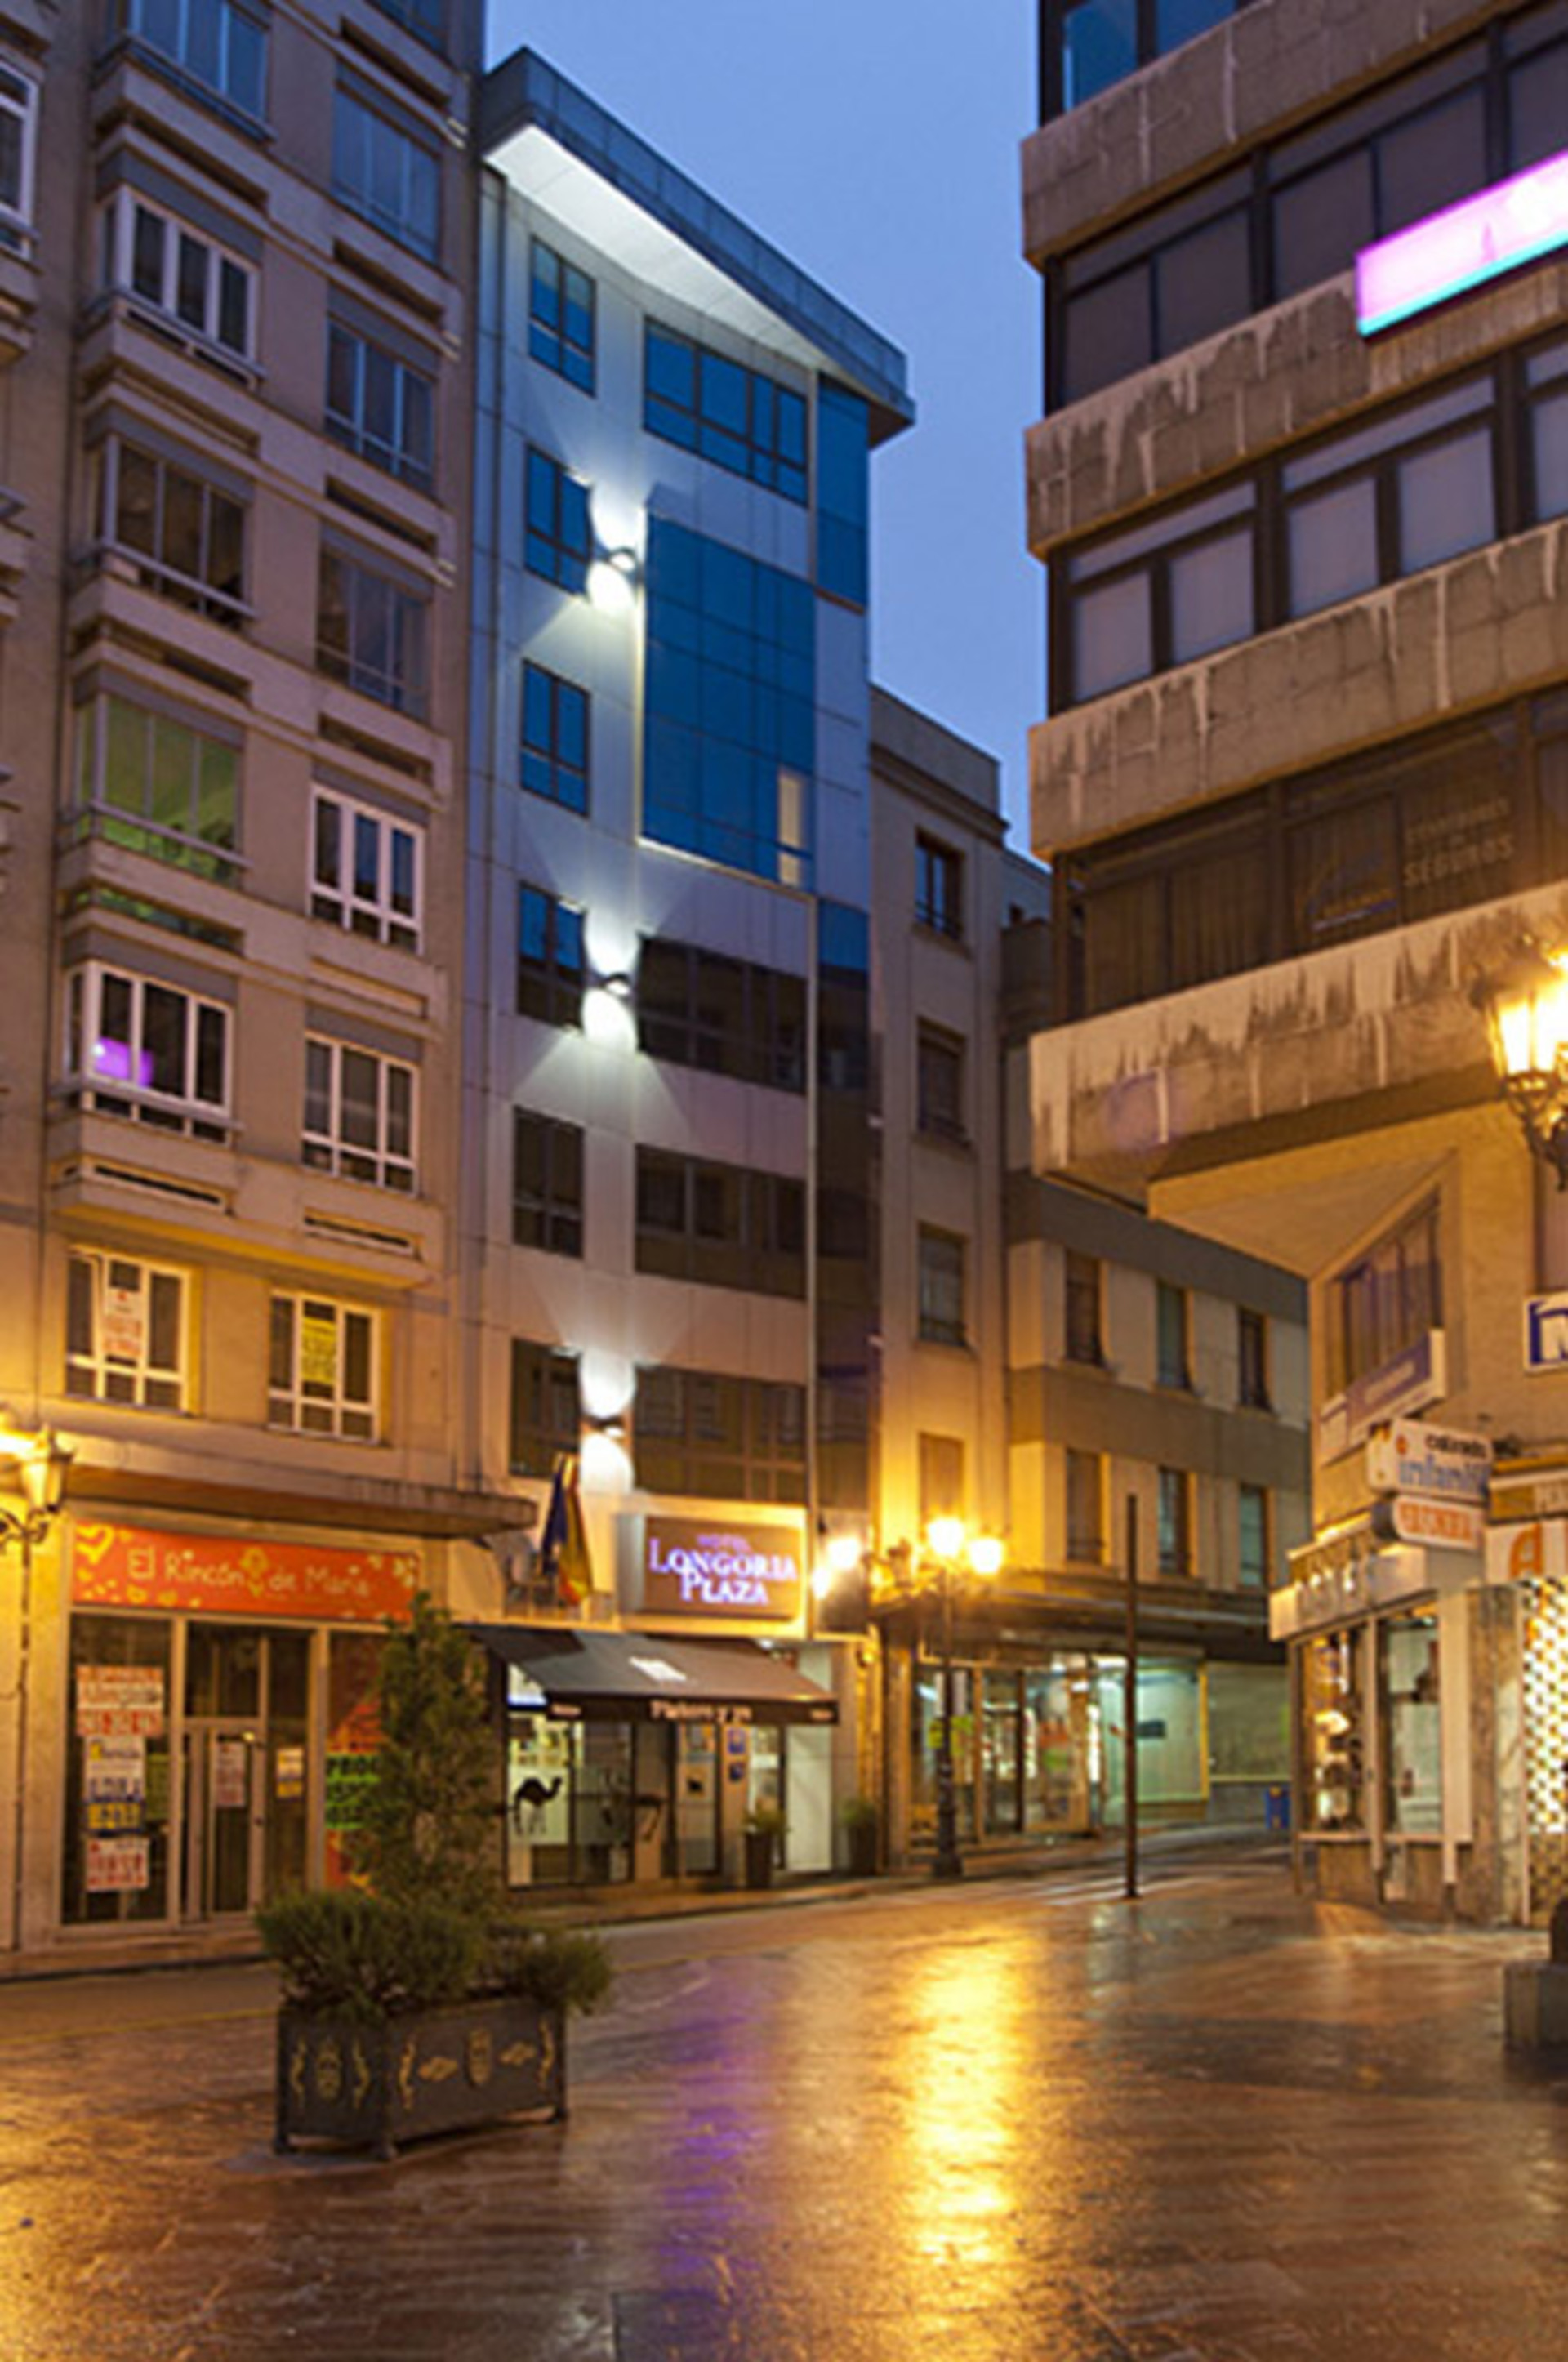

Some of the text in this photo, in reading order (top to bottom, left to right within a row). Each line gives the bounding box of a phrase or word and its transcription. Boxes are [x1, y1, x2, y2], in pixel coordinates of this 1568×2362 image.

[127, 1547, 156, 1580] El
[165, 1549, 245, 1587] Rincón
[269, 1566, 297, 1592] de
[649, 1537, 798, 1581] LONGORIA
[681, 1568, 770, 1606] PLAZA
